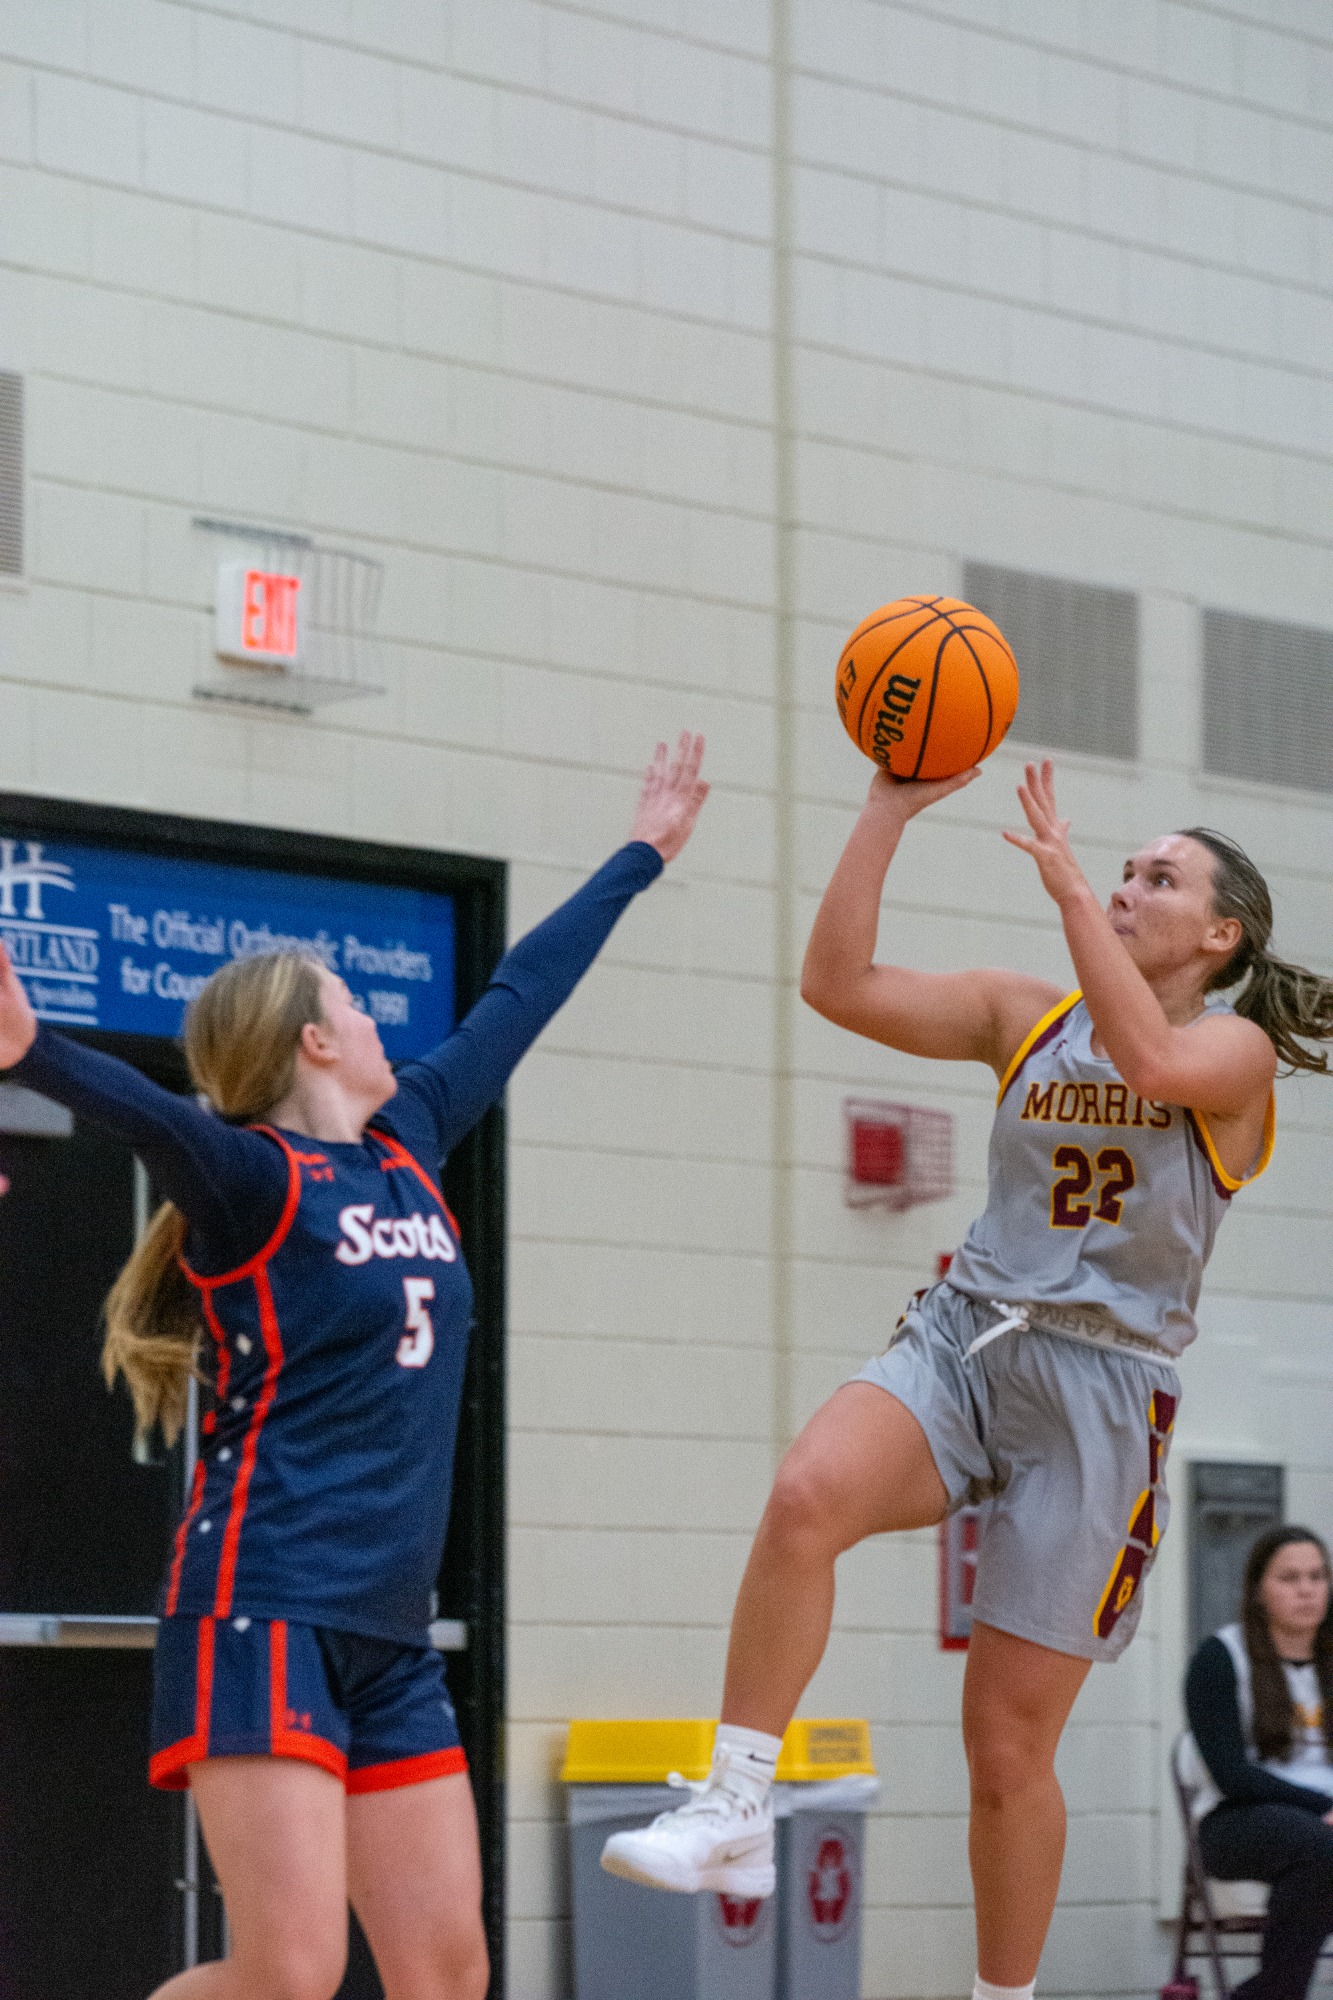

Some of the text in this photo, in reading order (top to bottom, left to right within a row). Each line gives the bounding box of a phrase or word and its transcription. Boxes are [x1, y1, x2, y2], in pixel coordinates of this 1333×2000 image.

[242, 568, 300, 656] EXIT
[872, 673, 921, 770] Wilso
[108, 903, 148, 946] The
[153, 910, 225, 955] Official
[344, 934, 433, 982] Providers
[121, 956, 151, 994] for
[1019, 1081, 1172, 1130] MORRIS
[1049, 1144, 1136, 1230] 22
[335, 1203, 457, 1266] Scots
[395, 1276, 436, 1369] 5
